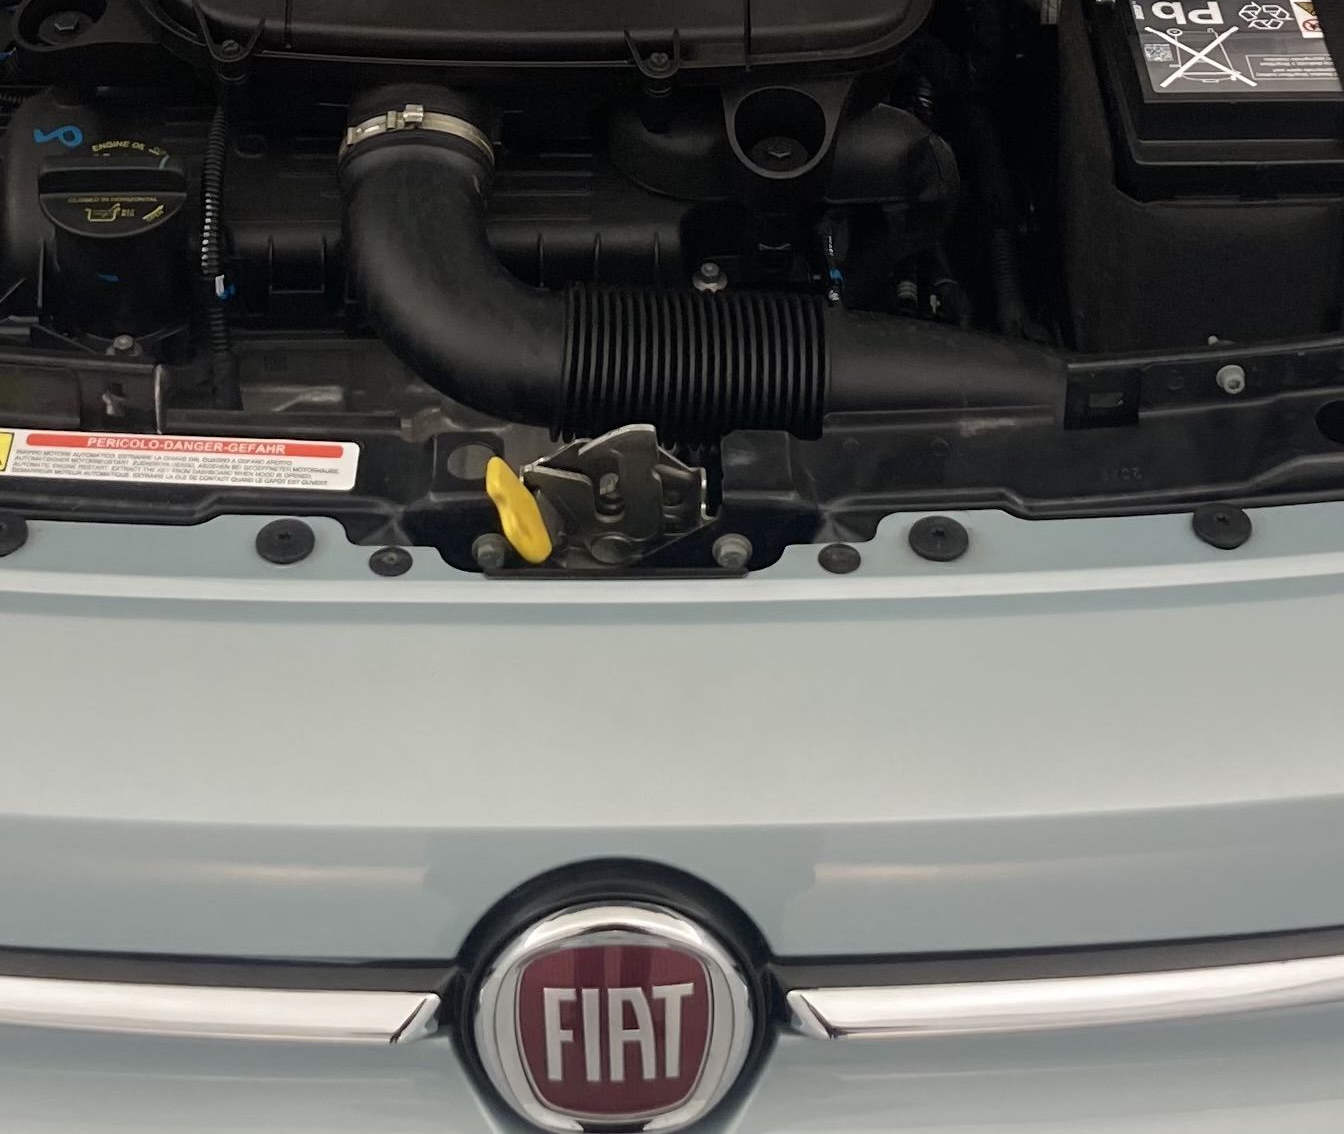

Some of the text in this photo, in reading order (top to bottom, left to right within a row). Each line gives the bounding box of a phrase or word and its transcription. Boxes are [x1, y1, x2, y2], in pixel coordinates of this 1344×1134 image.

[1152, 0, 1224, 24] Pb
[92, 141, 130, 152] ENGINE
[87, 437, 286, 455] PERICOLO-DANGER-GEFAHR
[543, 982, 695, 1083] FIAT
